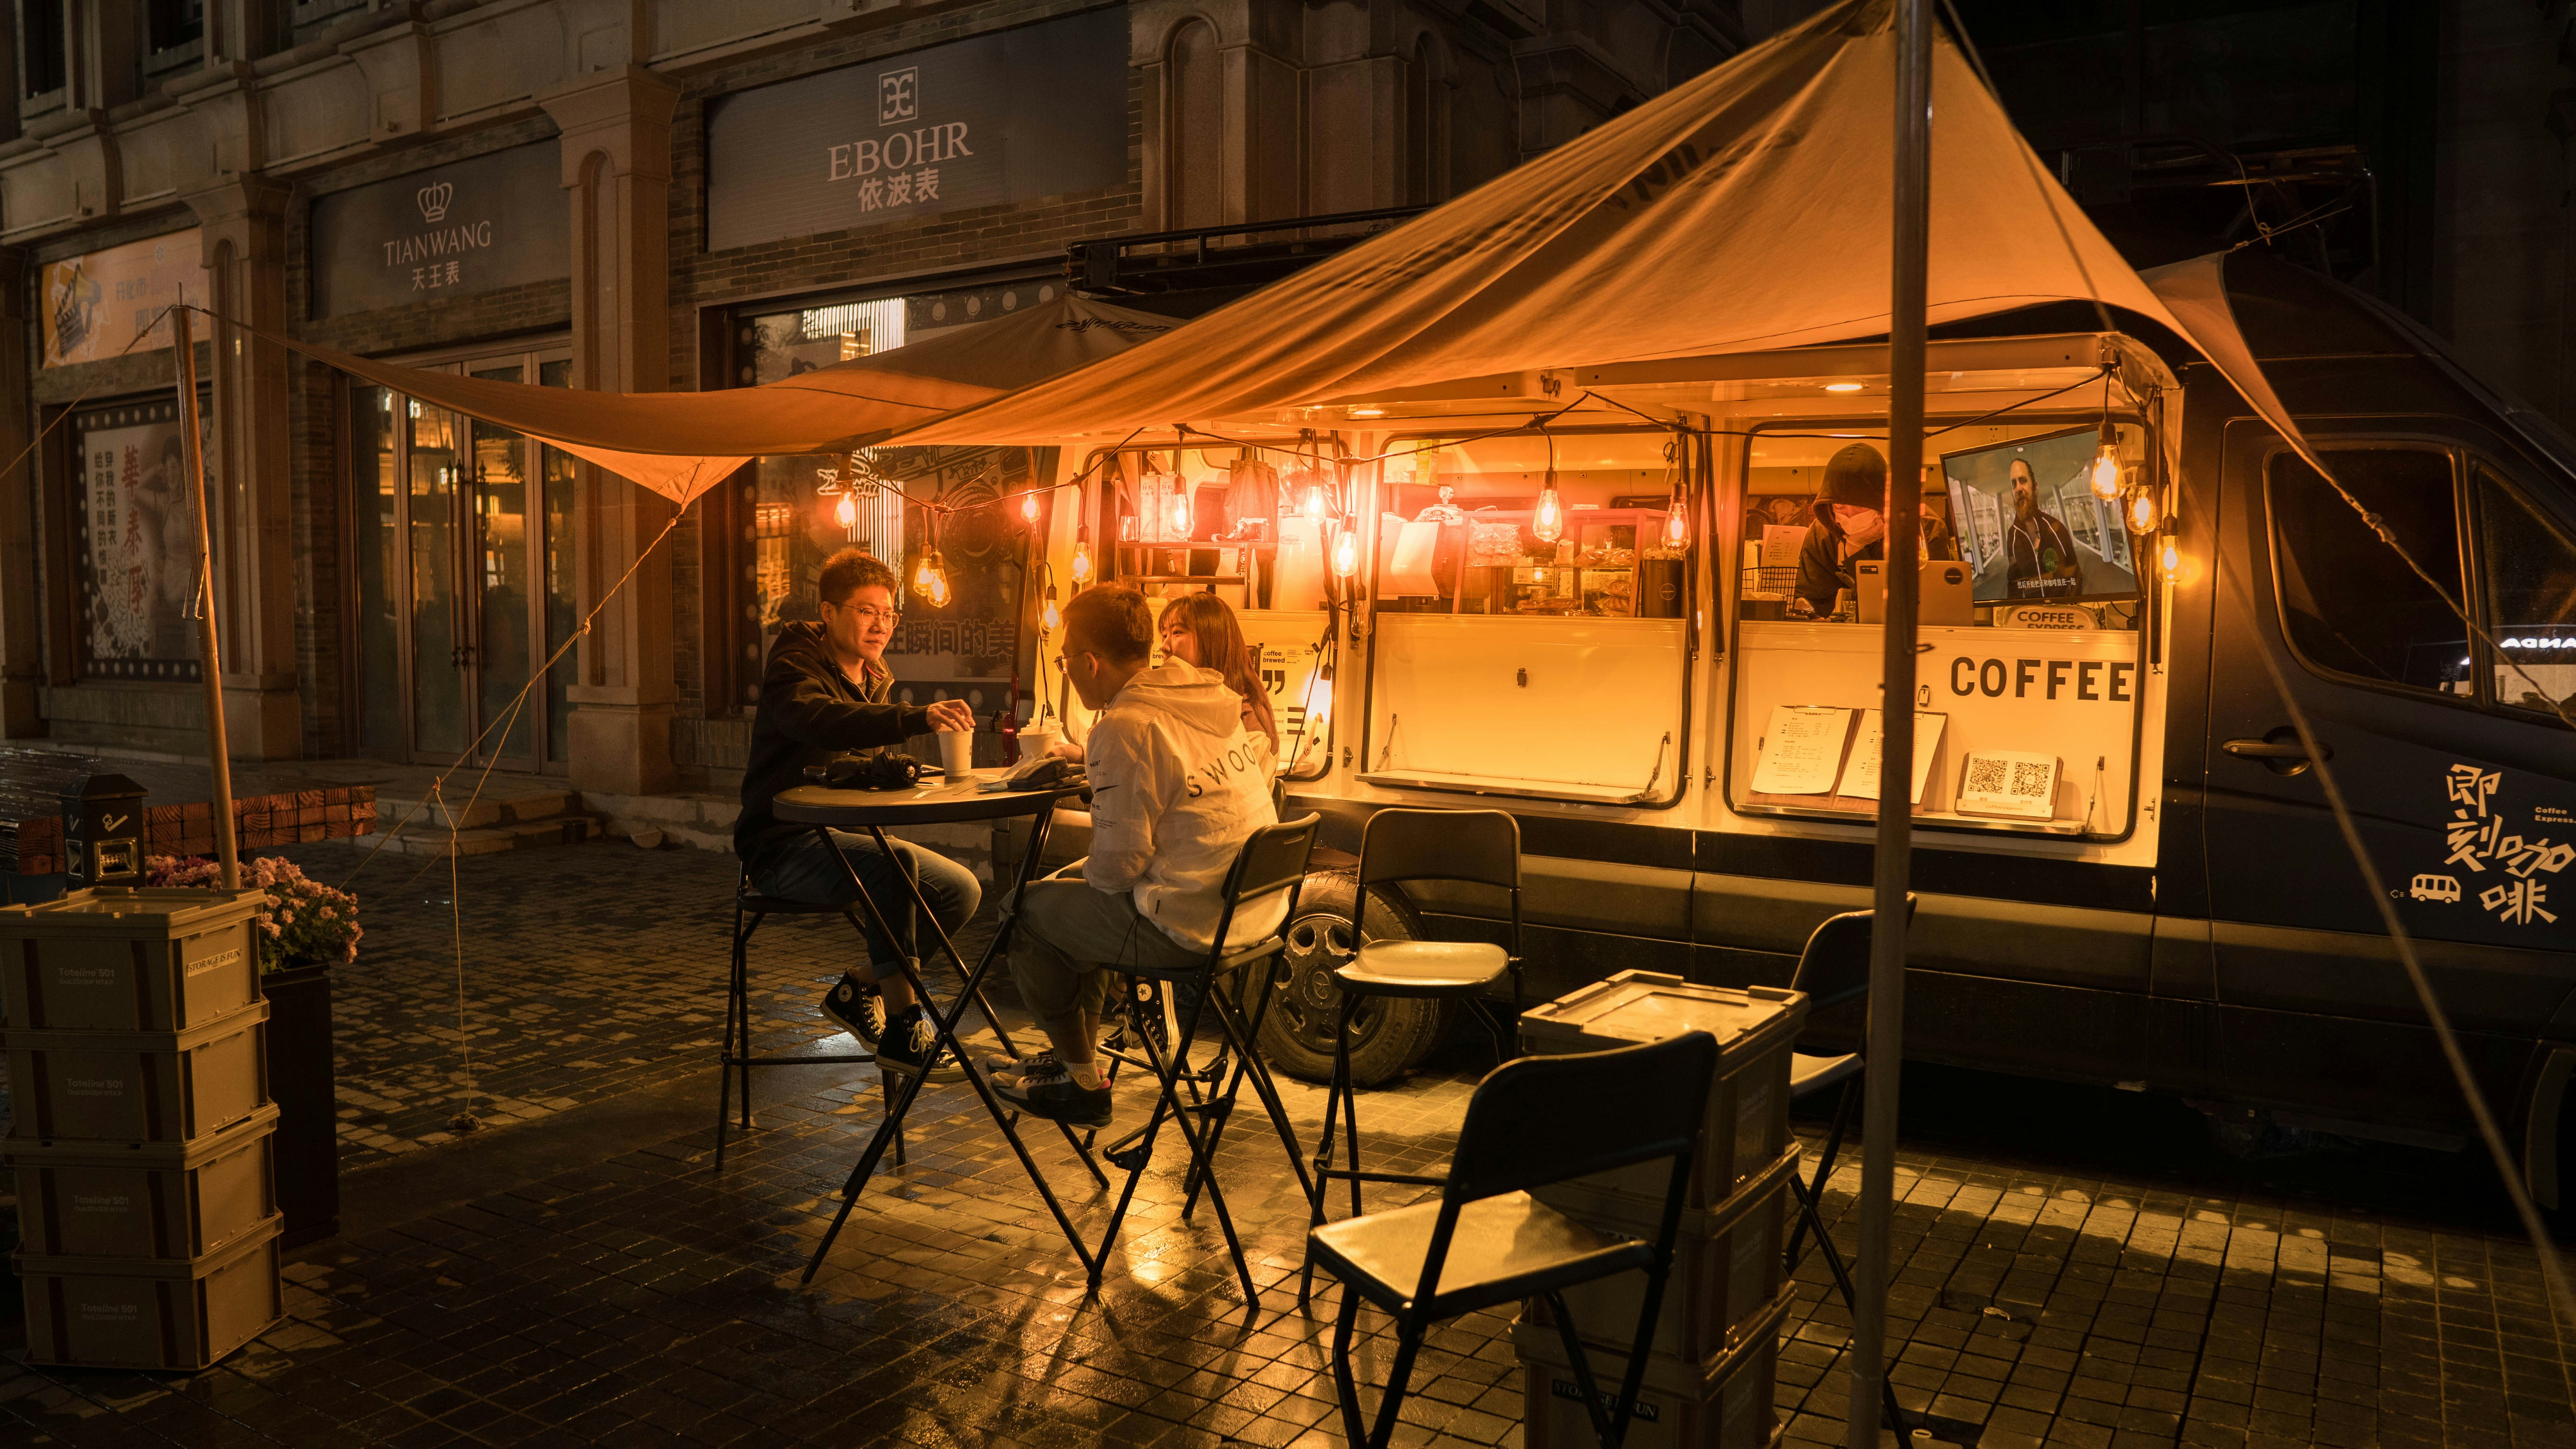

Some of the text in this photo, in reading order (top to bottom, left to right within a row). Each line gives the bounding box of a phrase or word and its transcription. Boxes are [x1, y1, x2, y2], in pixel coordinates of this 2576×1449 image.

[827, 121, 973, 182] EBOHR
[859, 167, 940, 213] 依波表
[384, 221, 491, 267] TIANWANG
[412, 261, 459, 291] 天王表
[2017, 611, 2075, 623] COFFEE
[1951, 656, 2135, 702] COFFEE
[189, 948, 242, 972] STORAGE IS FUN
[99, 968, 115, 977] 501
[107, 1079, 123, 1088] 501
[113, 1196, 129, 1205] 501
[121, 1305, 137, 1313] 501
